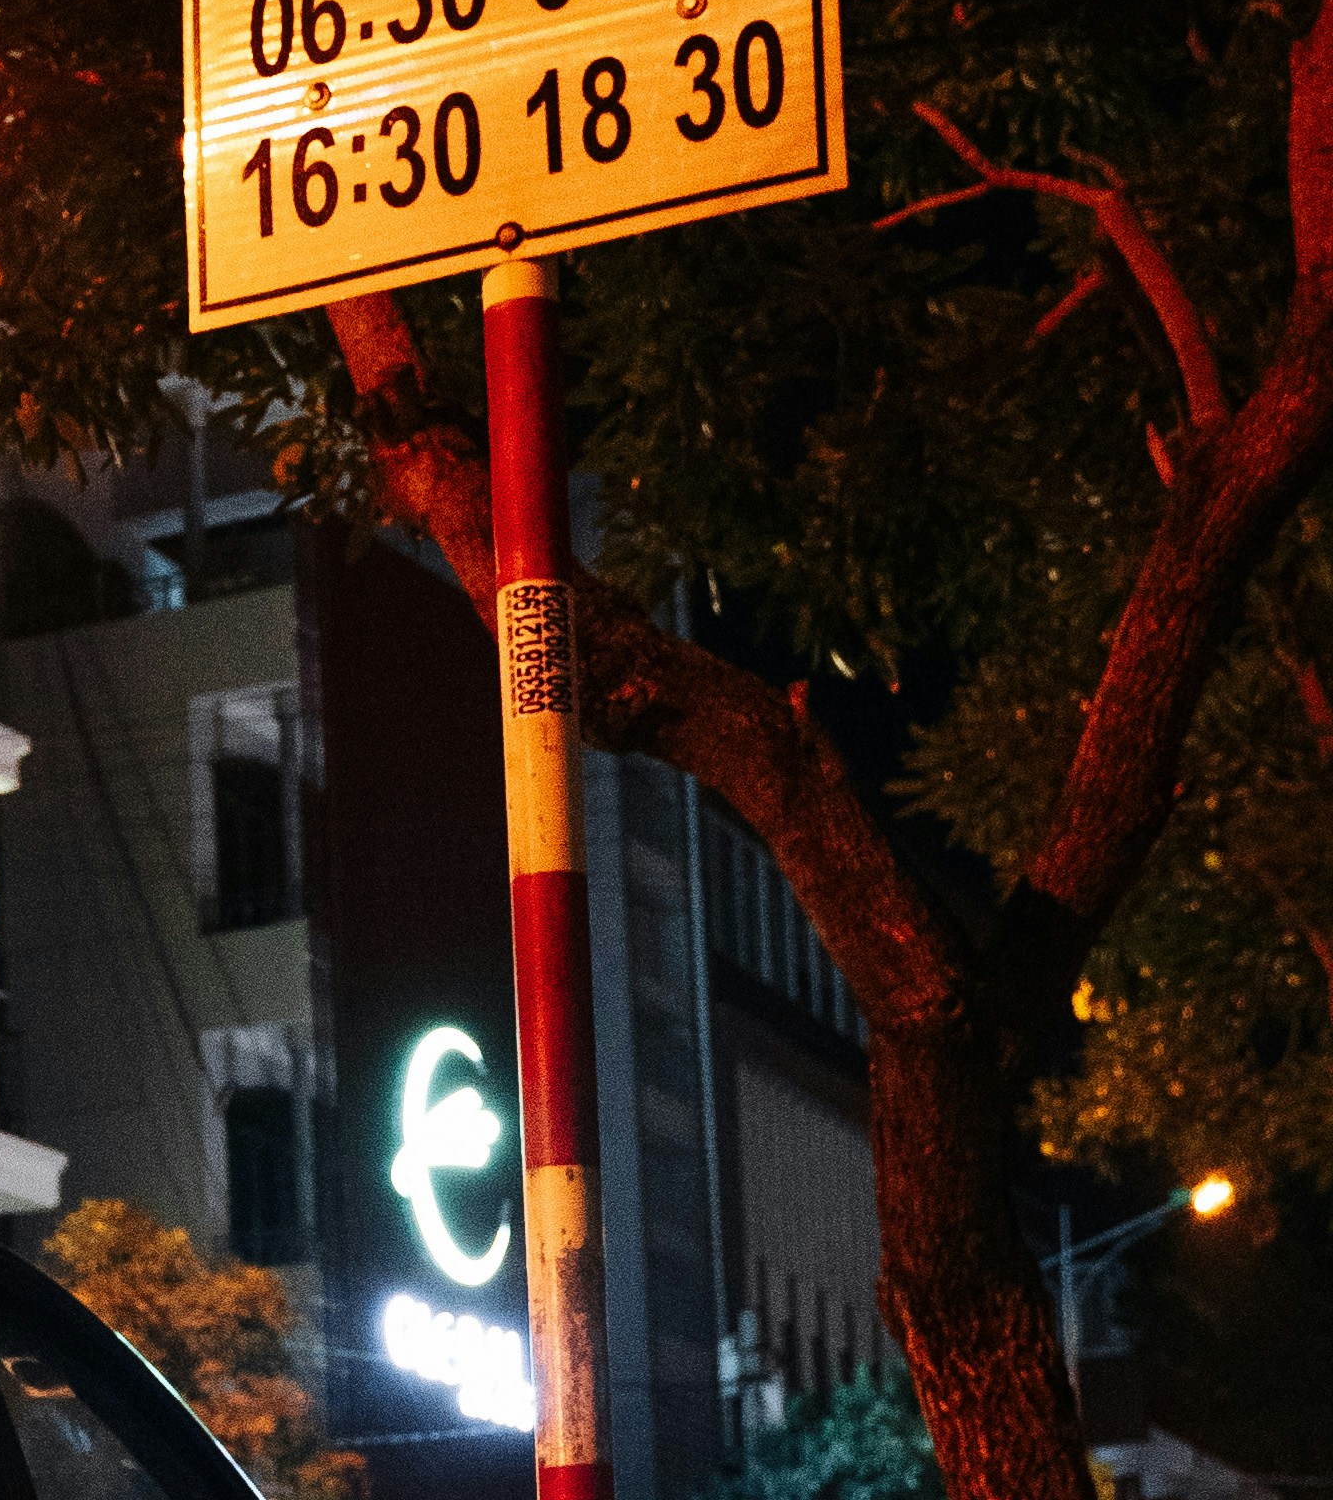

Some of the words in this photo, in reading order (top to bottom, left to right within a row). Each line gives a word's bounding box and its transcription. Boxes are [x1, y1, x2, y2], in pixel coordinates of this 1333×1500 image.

[241, 90, 481, 238] 16:30
[526, 55, 632, 174] 18
[673, 19, 785, 143] 30
